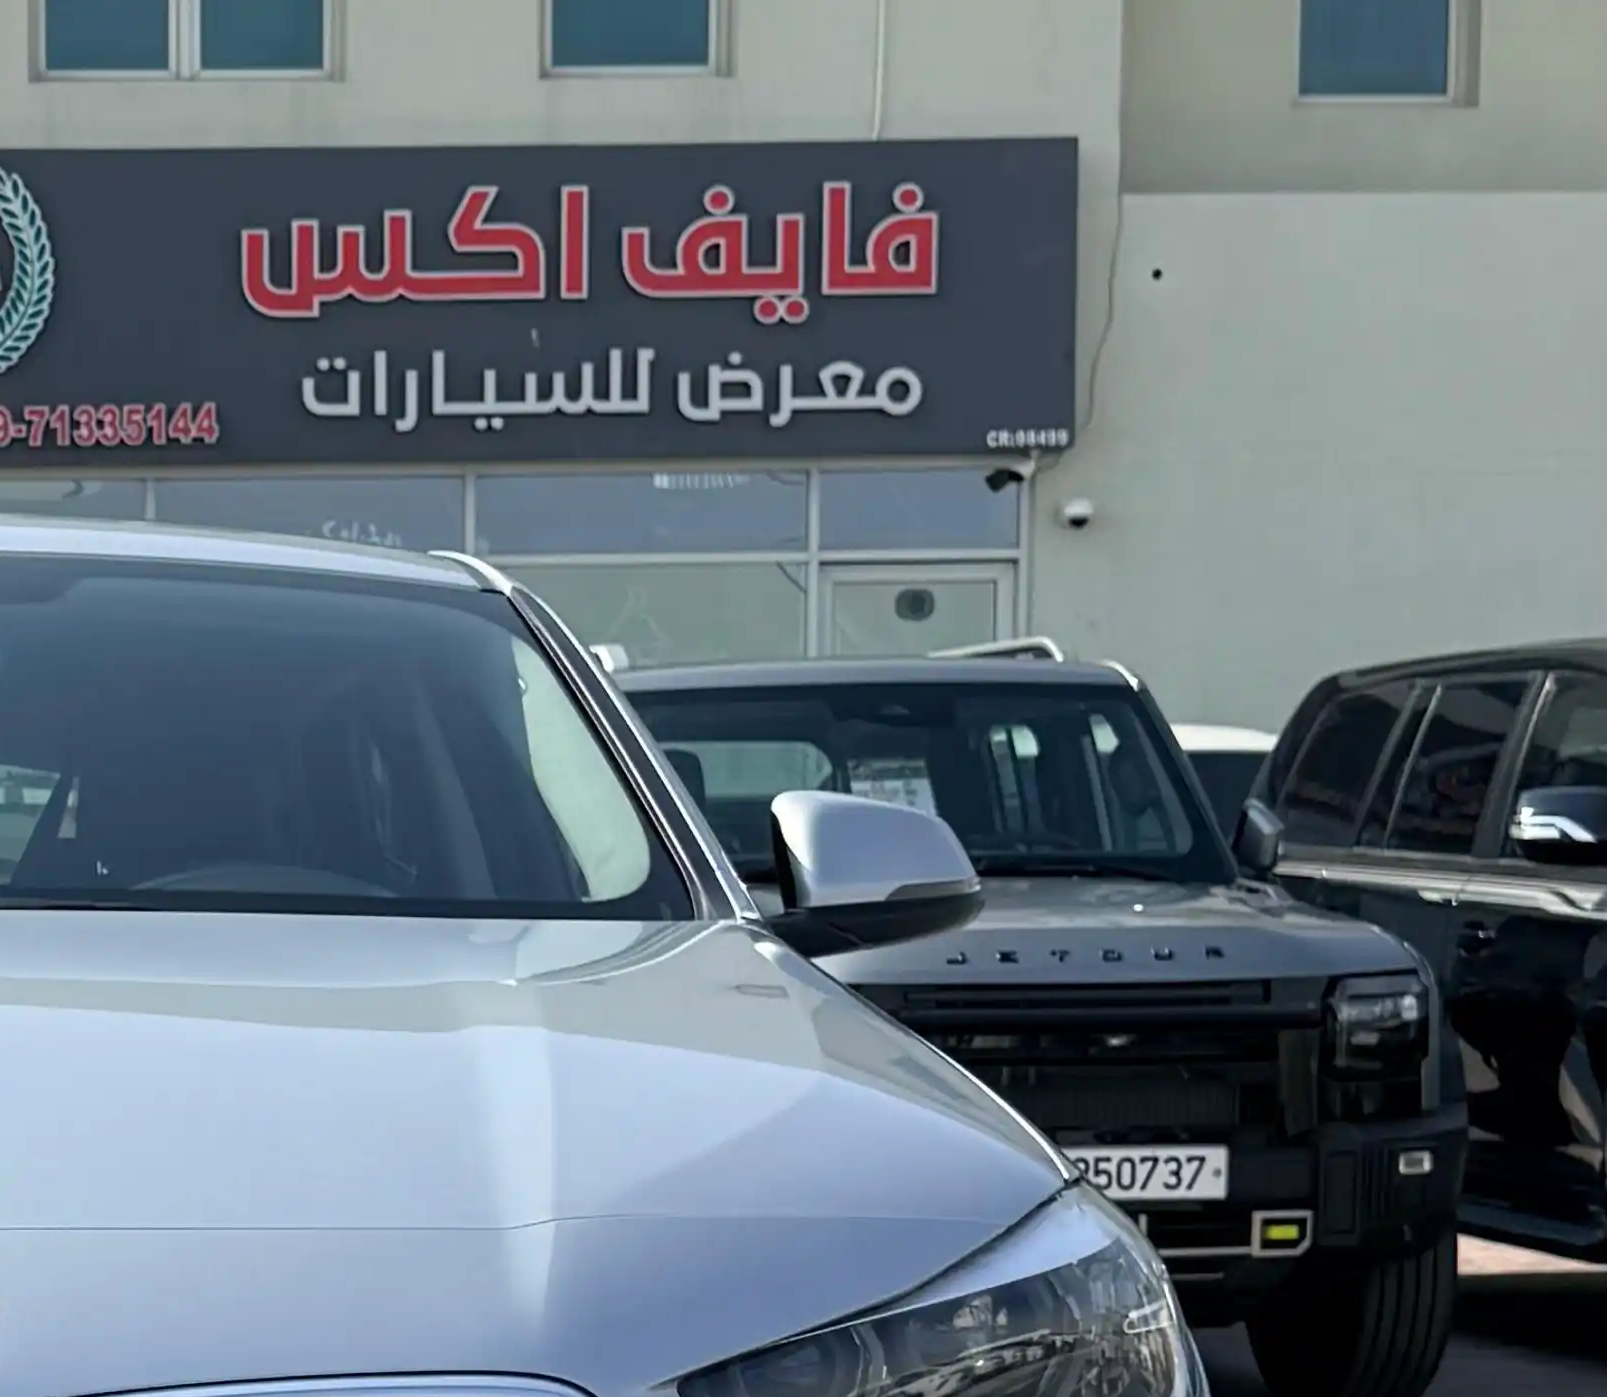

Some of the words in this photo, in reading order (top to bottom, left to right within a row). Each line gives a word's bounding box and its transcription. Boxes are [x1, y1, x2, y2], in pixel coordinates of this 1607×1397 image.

[240, 184, 591, 320] اكس
[621, 180, 939, 324] فايف
[300, 348, 657, 433] للسيارات
[676, 351, 924, 429] معرض
[946, 946, 1226, 965] JETOUR
